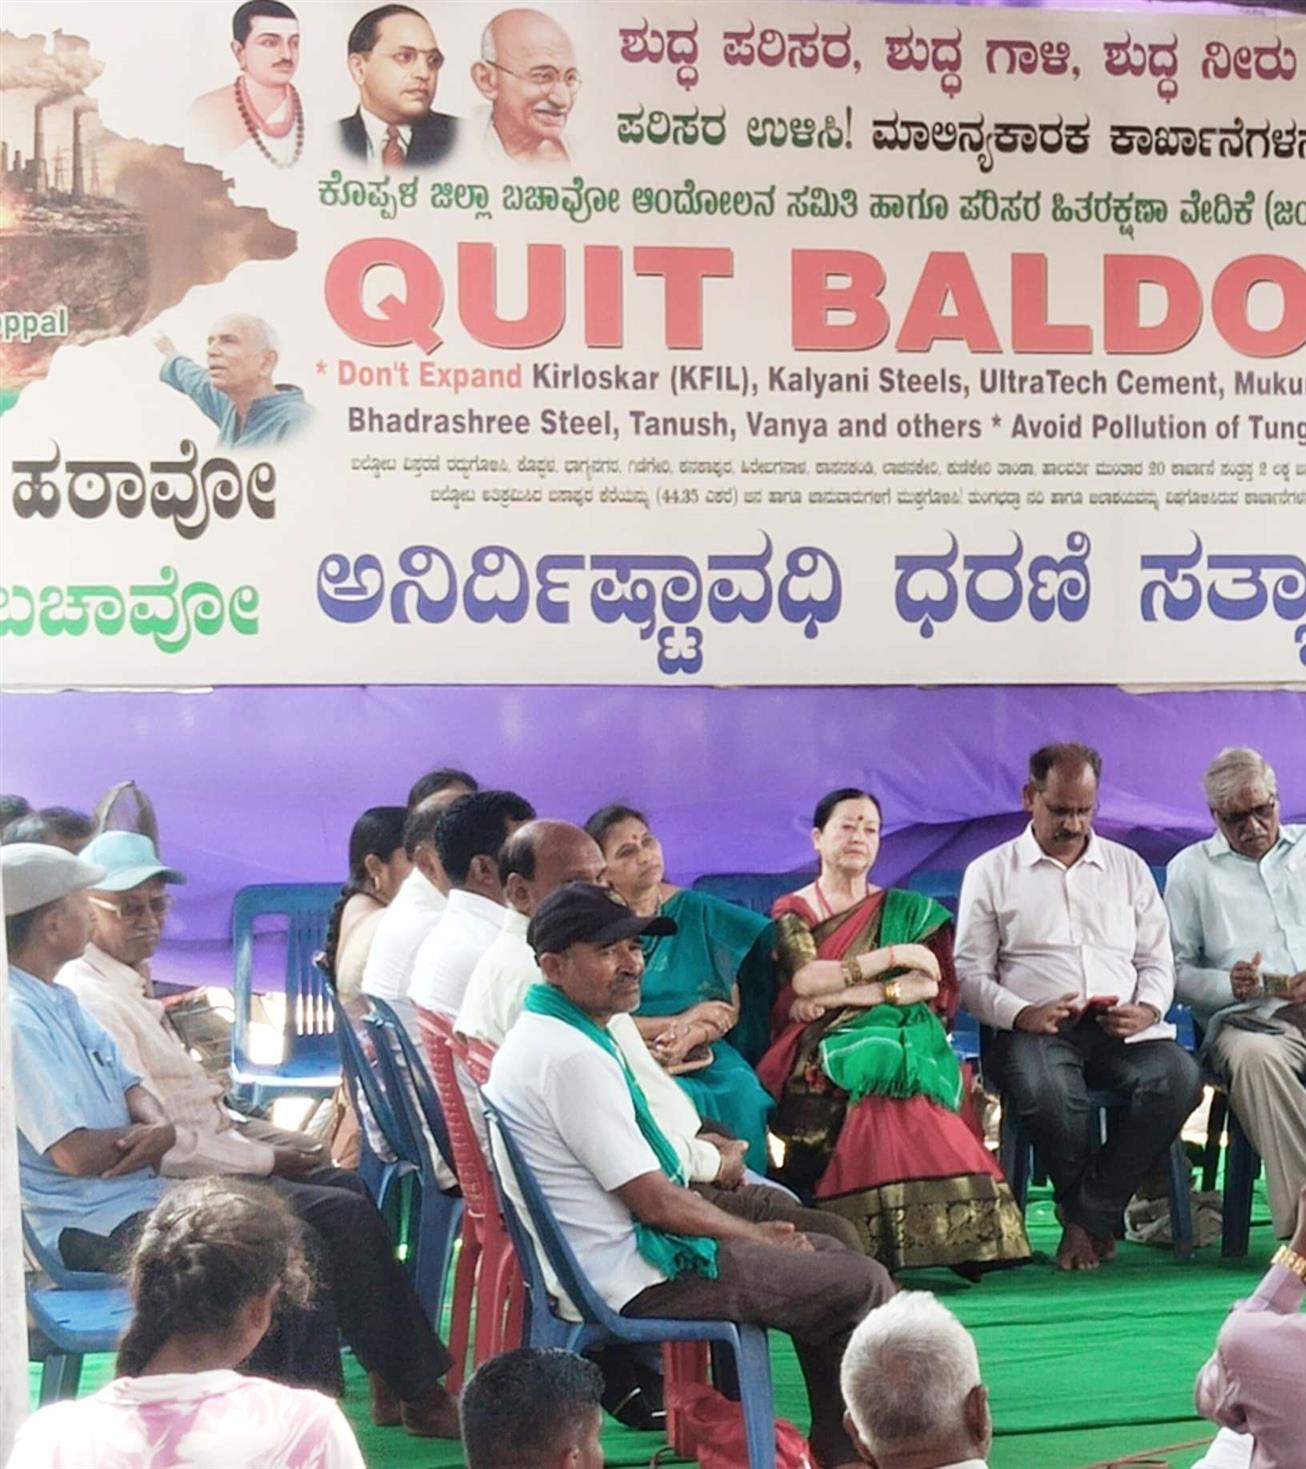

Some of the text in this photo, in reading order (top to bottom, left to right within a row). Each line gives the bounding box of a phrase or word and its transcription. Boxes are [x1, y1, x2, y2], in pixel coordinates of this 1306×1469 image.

[619, 18, 699, 92] ಶುದ್ಧ
[723, 21, 861, 74] ಪರಿಸರ,
[885, 25, 962, 99] ಶುದ್ಧ
[986, 40, 1080, 80] ಗಾಳಿ,
[1103, 32, 1178, 104] ಶುದ್ಧ
[1202, 36, 1297, 81] ನೀರು
[617, 105, 726, 146] ಪರಿಸರ
[747, 105, 852, 149] ಉಳಿಸಿ!
[872, 111, 1090, 173] ಮಾಲಿನ್ಯಕಾರಕ
[318, 166, 422, 220] ಕೊಪ್ಪಳ
[430, 182, 493, 220] ಜಿಲ್ಲಾ
[503, 176, 620, 223] ಬಚಾವೋ
[632, 179, 776, 217] ಆಂದೋಲನ
[787, 185, 858, 218] ಸಮಿತಿ
[870, 188, 949, 220] ಹಾಗೂ
[960, 189, 1042, 222] ಪರಿಸರ
[1051, 191, 1168, 240] ಹಿತರಕ್ಷಣಾ
[1180, 189, 1255, 225] ವೇದಿಕೆ
[324, 237, 735, 355] QUIT
[338, 360, 409, 387] Don't
[420, 361, 522, 395] Expand
[533, 363, 660, 390] Kirloskar
[671, 365, 758, 397] (KFIL),
[769, 366, 868, 399] Kalyani
[879, 367, 969, 399] Steels,
[980, 368, 1107, 394] UltraTech
[1117, 369, 1224, 400] Cement,
[349, 407, 530, 434] Bhadrashree
[541, 409, 618, 440] Steel,
[629, 410, 736, 442] Tanush,
[746, 411, 827, 444] Vanya
[838, 412, 887, 438] and
[897, 413, 981, 438] others
[1012, 413, 1082, 439] Avoid
[1093, 414, 1207, 439] Pollution
[1216, 414, 1240, 439] of
[12, 439, 277, 540] ಹಠಾವೋ
[317, 529, 843, 674] ಅನಿರ್ದಿಷ್ಟಾವಧಿ
[895, 530, 1091, 639] ಧರಣಿ
